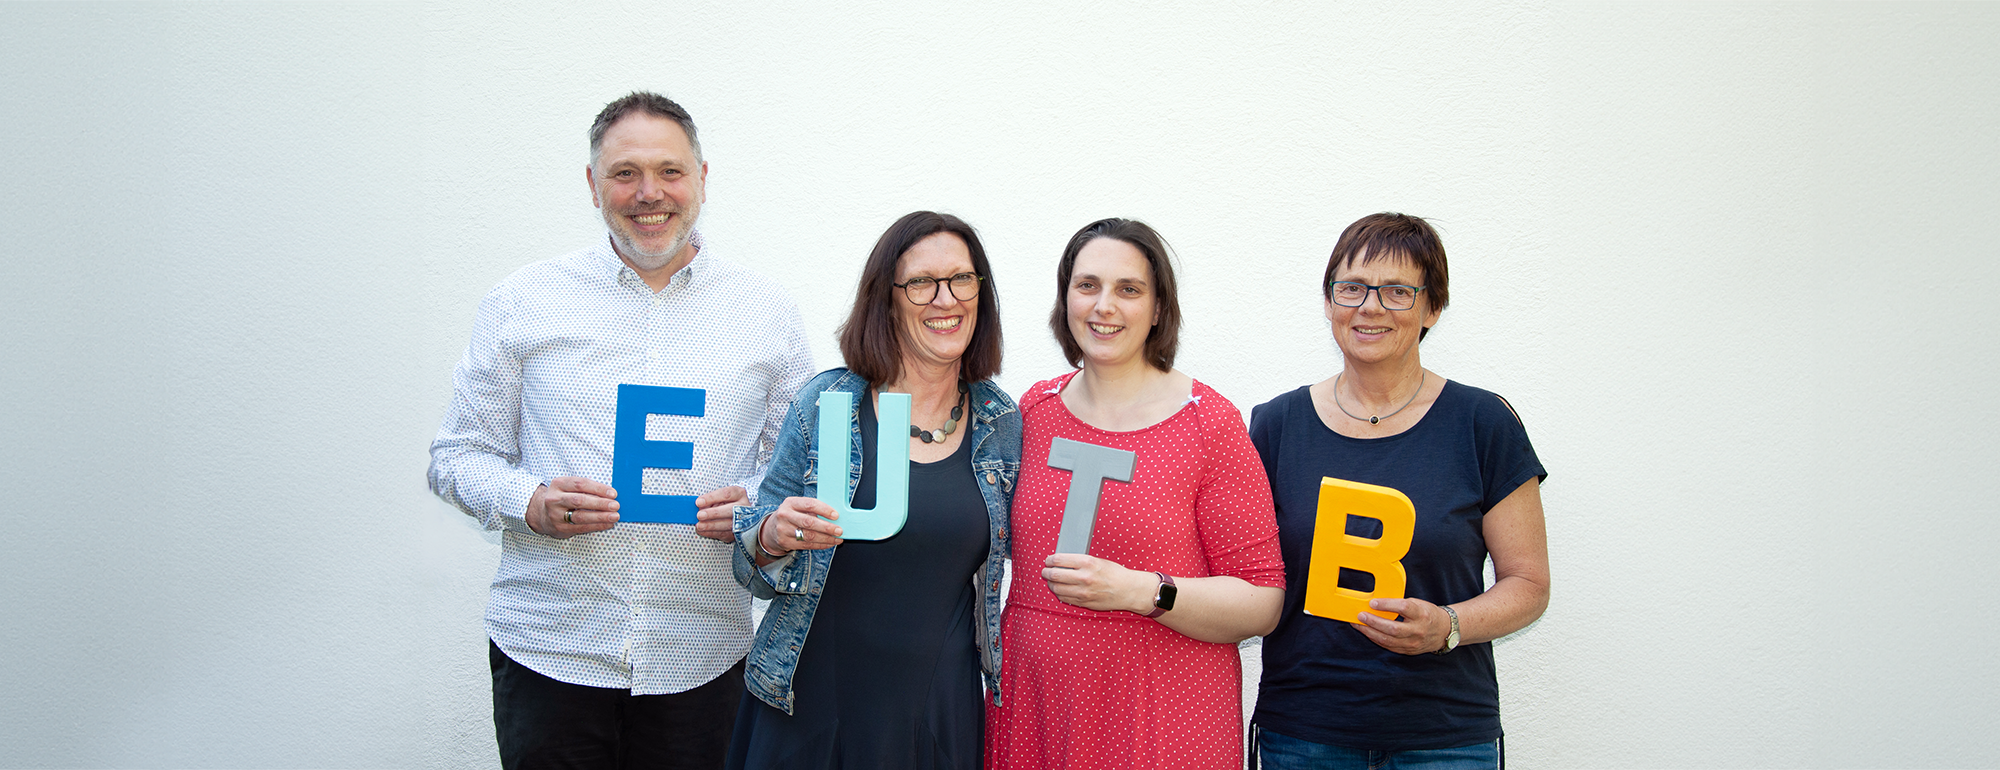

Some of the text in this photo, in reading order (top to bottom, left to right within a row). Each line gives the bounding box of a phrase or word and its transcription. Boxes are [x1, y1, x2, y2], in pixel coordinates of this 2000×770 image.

[612, 384, 706, 525] E
[817, 391, 911, 541] U
[1047, 437, 1138, 555] T
[1304, 476, 1416, 625] B
